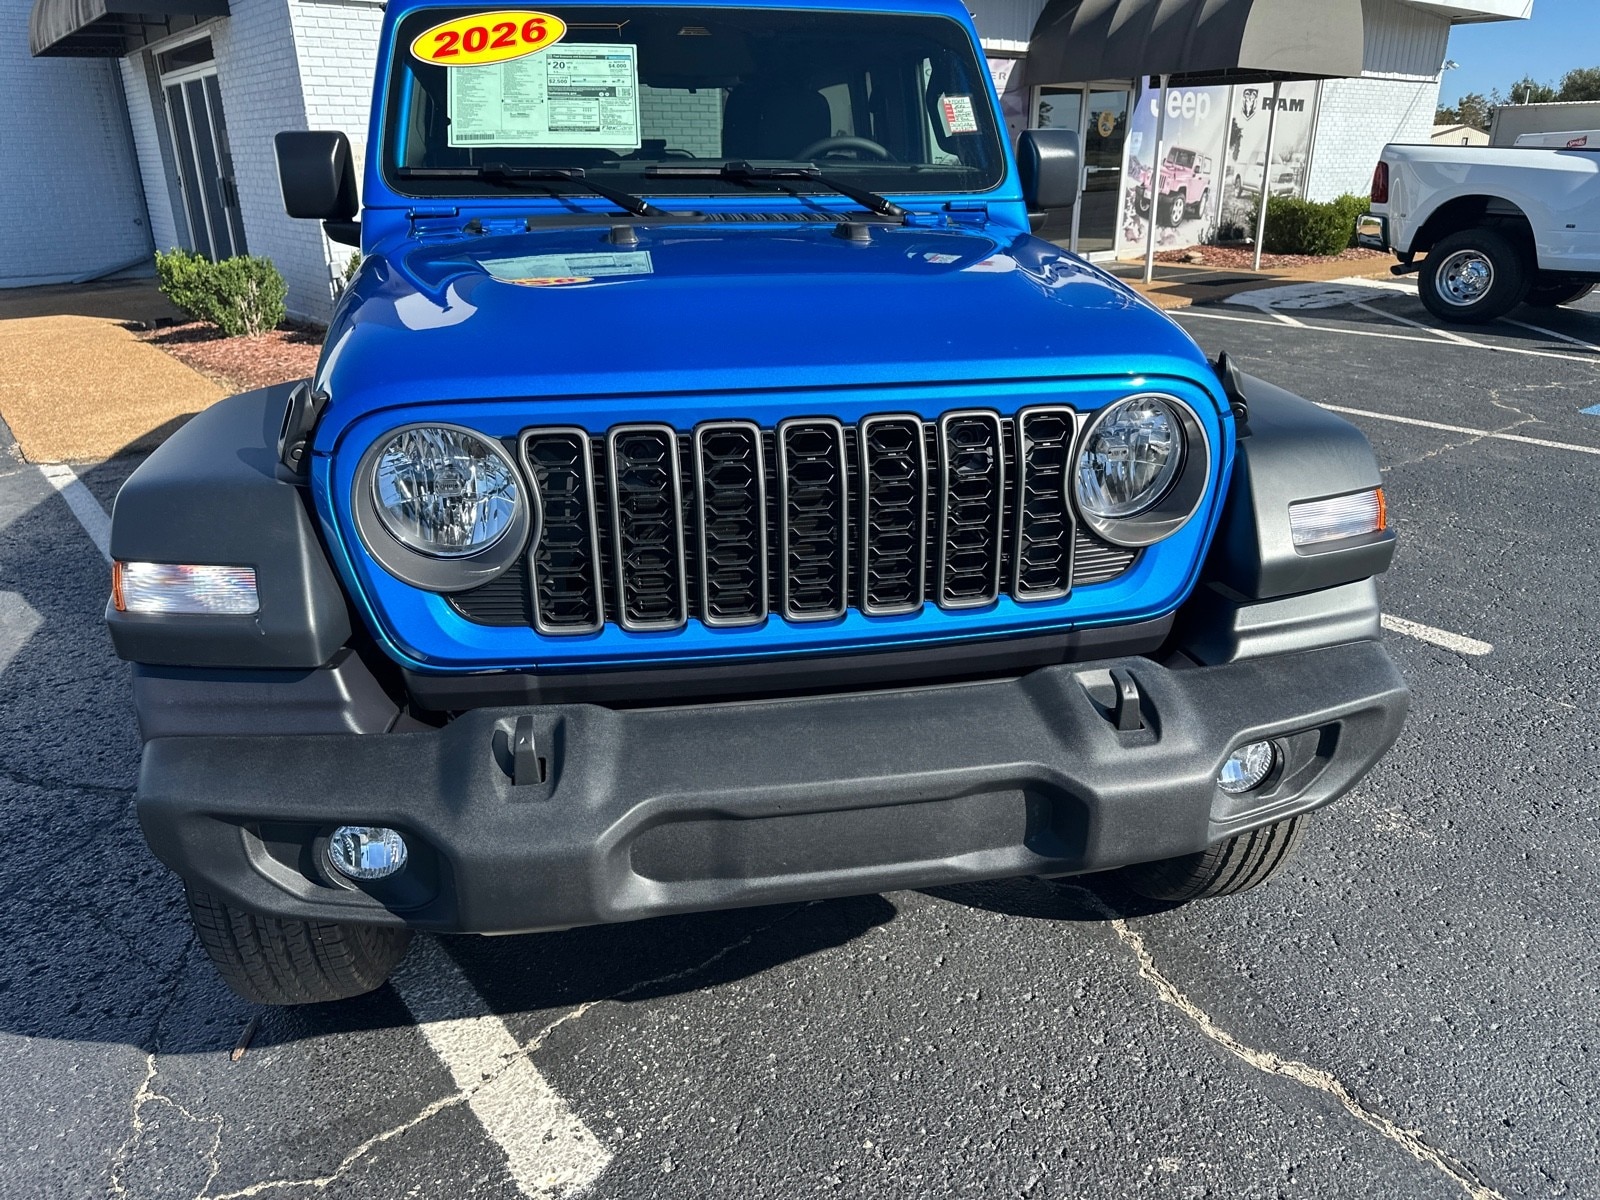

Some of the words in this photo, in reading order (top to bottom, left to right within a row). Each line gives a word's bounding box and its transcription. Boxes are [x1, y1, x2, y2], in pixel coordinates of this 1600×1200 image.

[432, 18, 547, 59] 2026
[552, 61, 566, 70] 20
[1261, 97, 1305, 112] RAM
